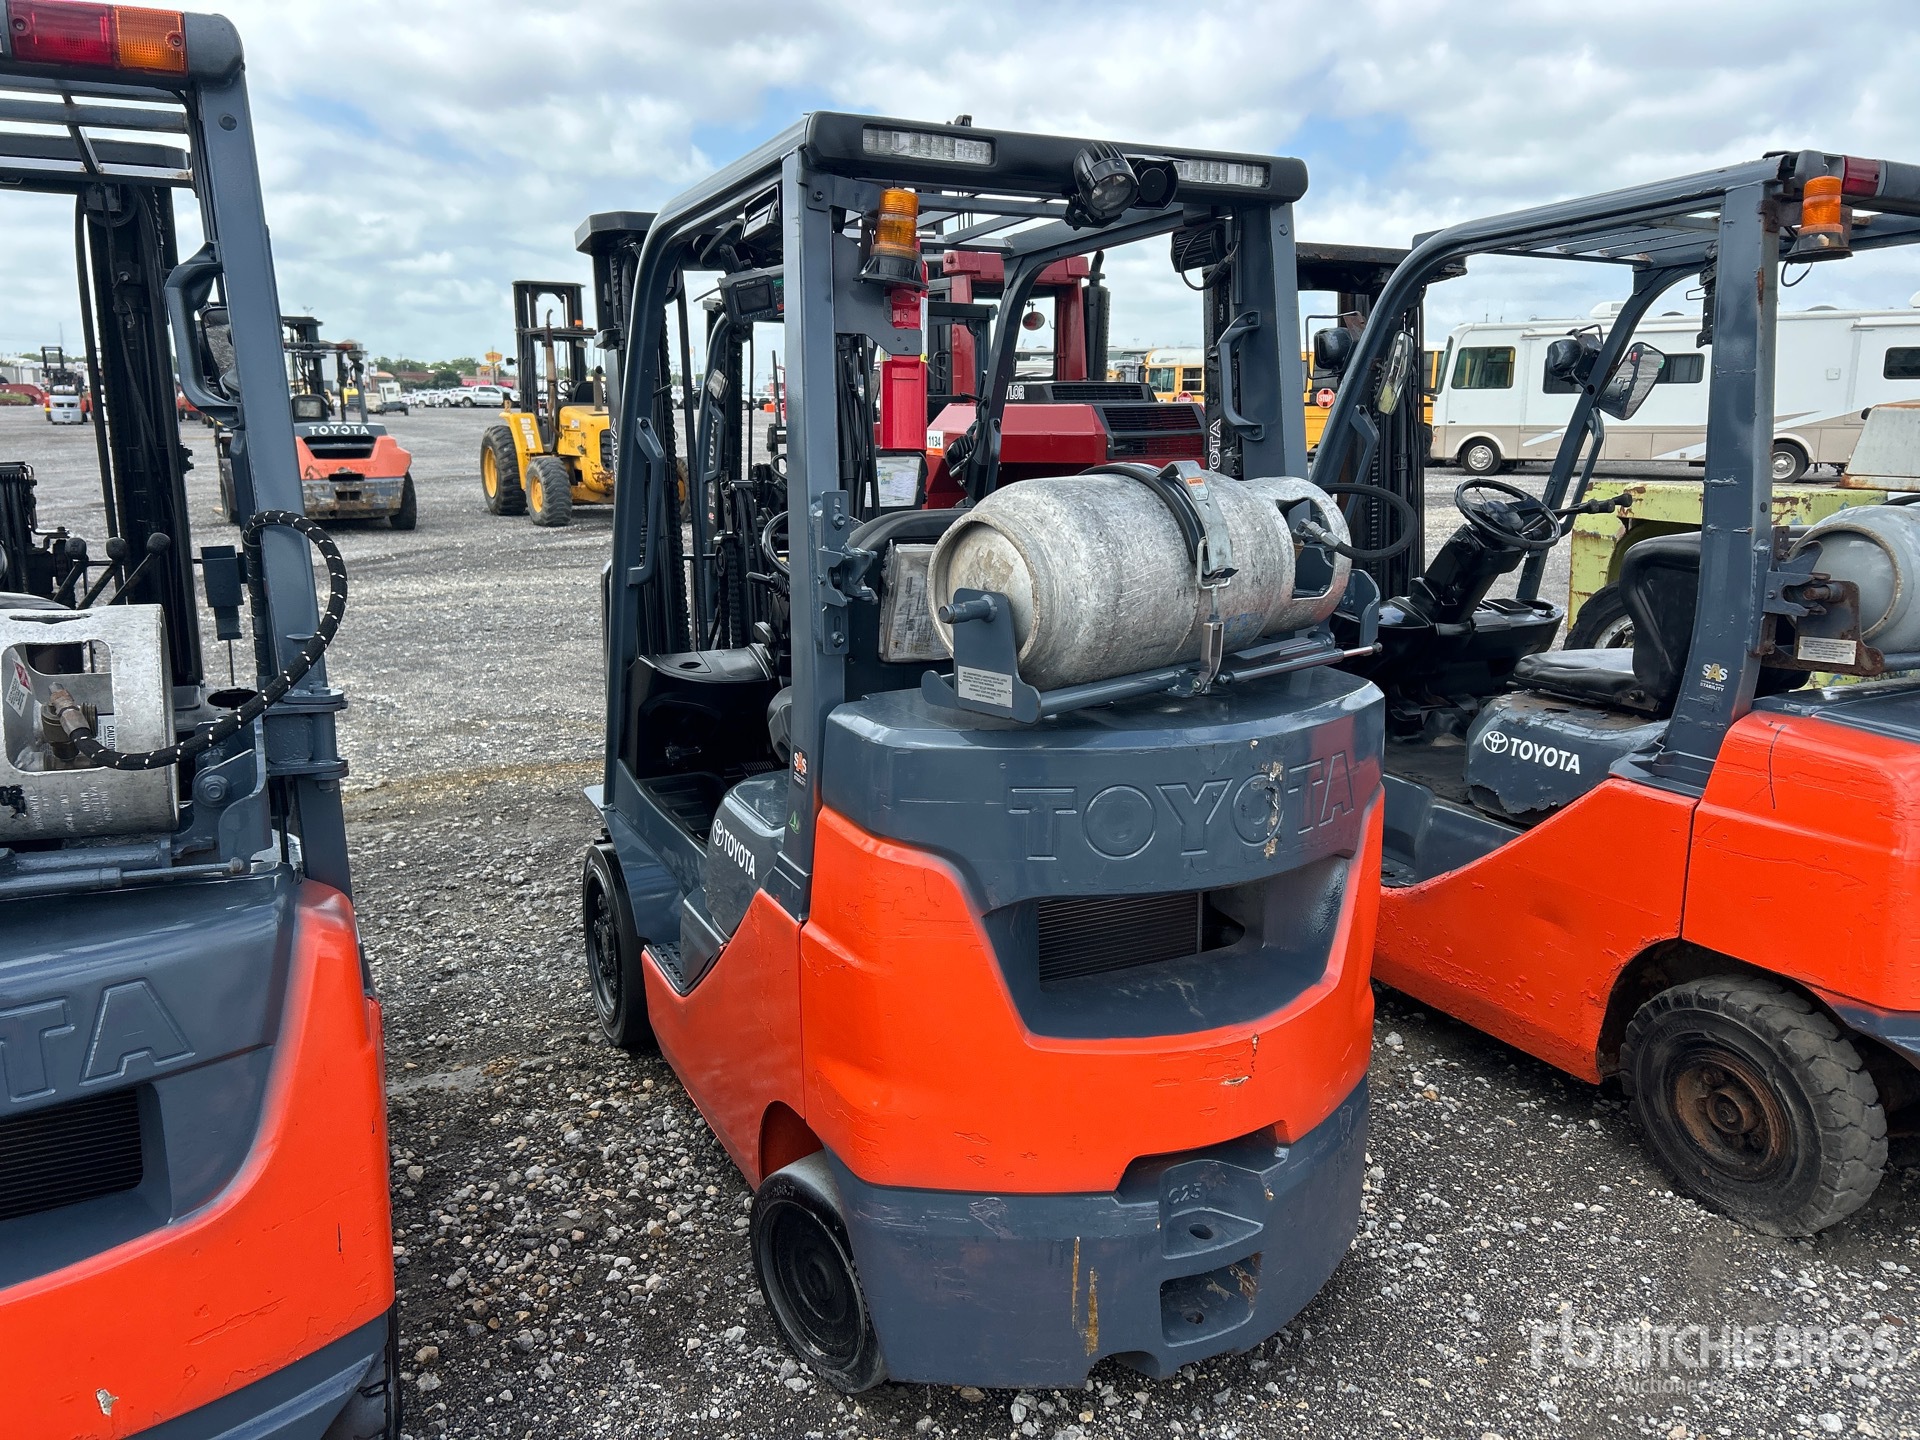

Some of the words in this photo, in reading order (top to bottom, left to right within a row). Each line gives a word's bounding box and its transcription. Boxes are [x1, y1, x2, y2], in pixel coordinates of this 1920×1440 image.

[1318, 394, 1333, 402] STOP
[308, 425, 370, 436] TOYOTA
[928, 436, 941, 447] 1134
[1209, 418, 1221, 472] OTA
[1702, 663, 1728, 683] SAS
[106, 725, 116, 749] CAUTIO
[1510, 737, 1580, 775] TOYOTA
[1007, 750, 1355, 861] TOYOTA
[724, 828, 756, 880] TOYOTA
[1167, 1181, 1204, 1205] C25
